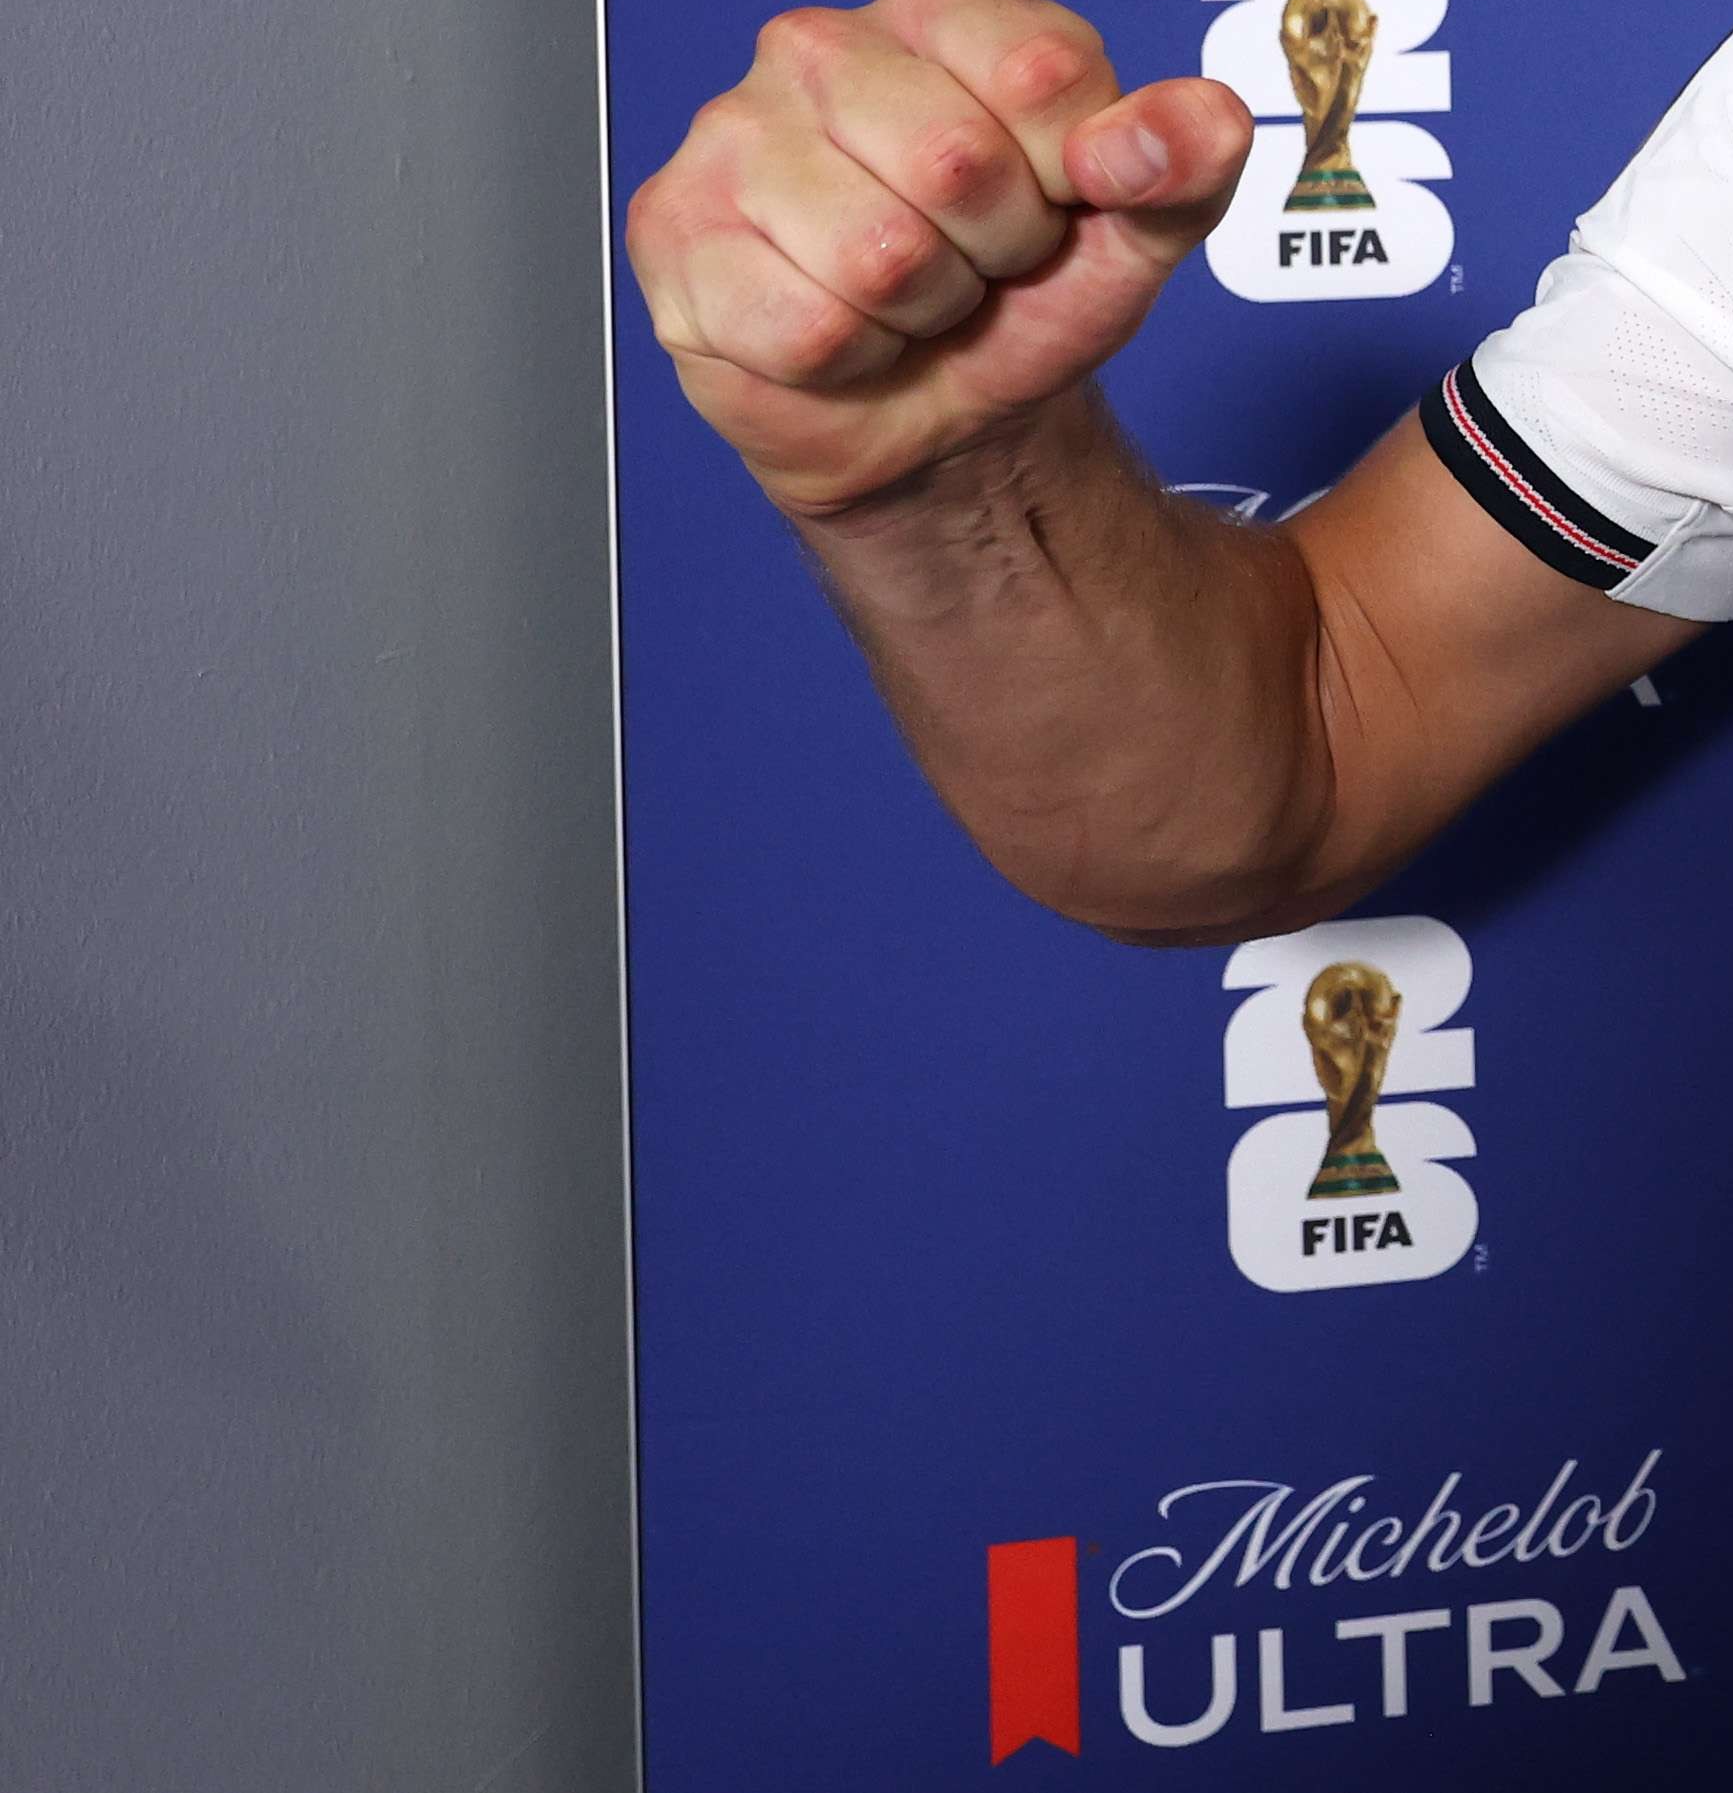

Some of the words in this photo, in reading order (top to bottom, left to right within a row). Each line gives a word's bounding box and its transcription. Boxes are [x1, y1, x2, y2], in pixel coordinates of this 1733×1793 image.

[1278, 228, 1390, 269] FIFA
[1301, 1210, 1414, 1258] FIFA
[1109, 1449, 1661, 1619] Michelob
[1118, 1586, 1686, 1748] ULTRA
